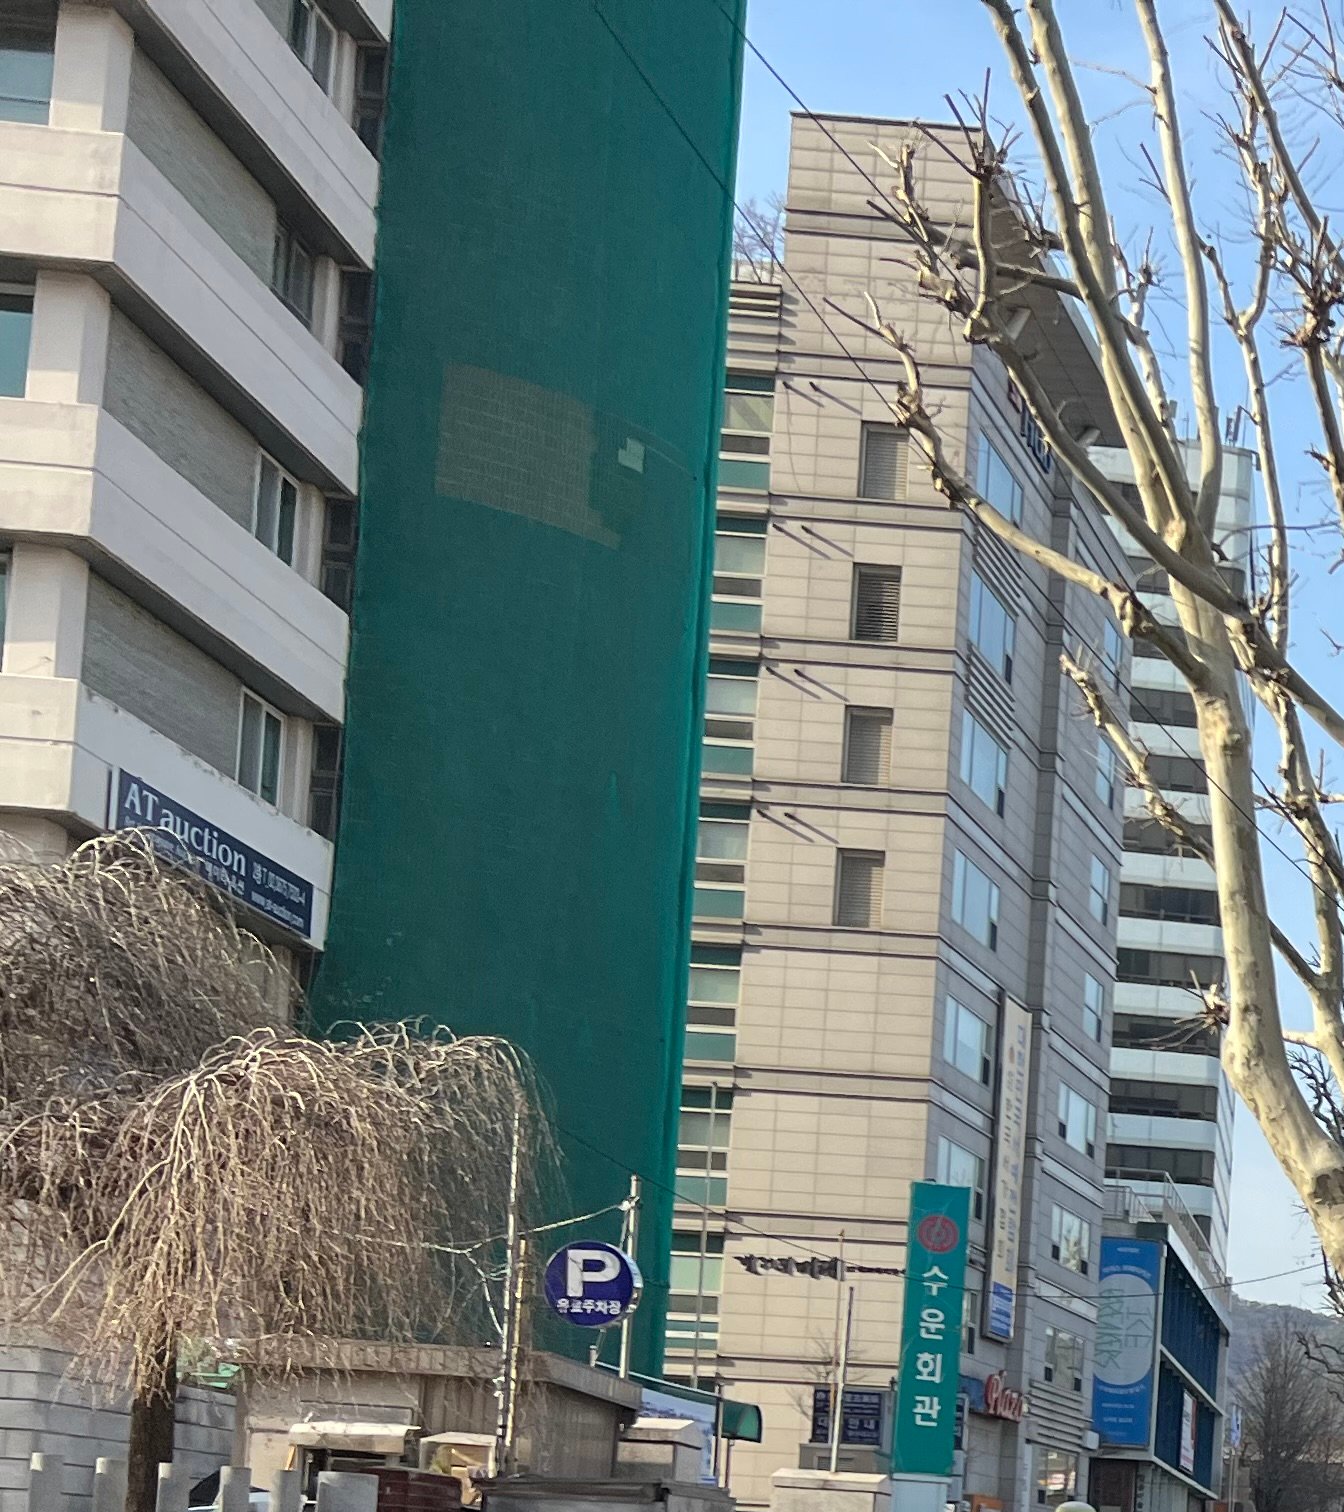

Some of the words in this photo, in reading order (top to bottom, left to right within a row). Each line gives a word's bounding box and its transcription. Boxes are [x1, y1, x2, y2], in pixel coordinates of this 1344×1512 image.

[124, 782, 159, 822] AT
[159, 808, 247, 877] auction
[557, 1298, 621, 1315] 유료주차장
[567, 1249, 621, 1297] P
[912, 1265, 949, 1427] 수운회관
